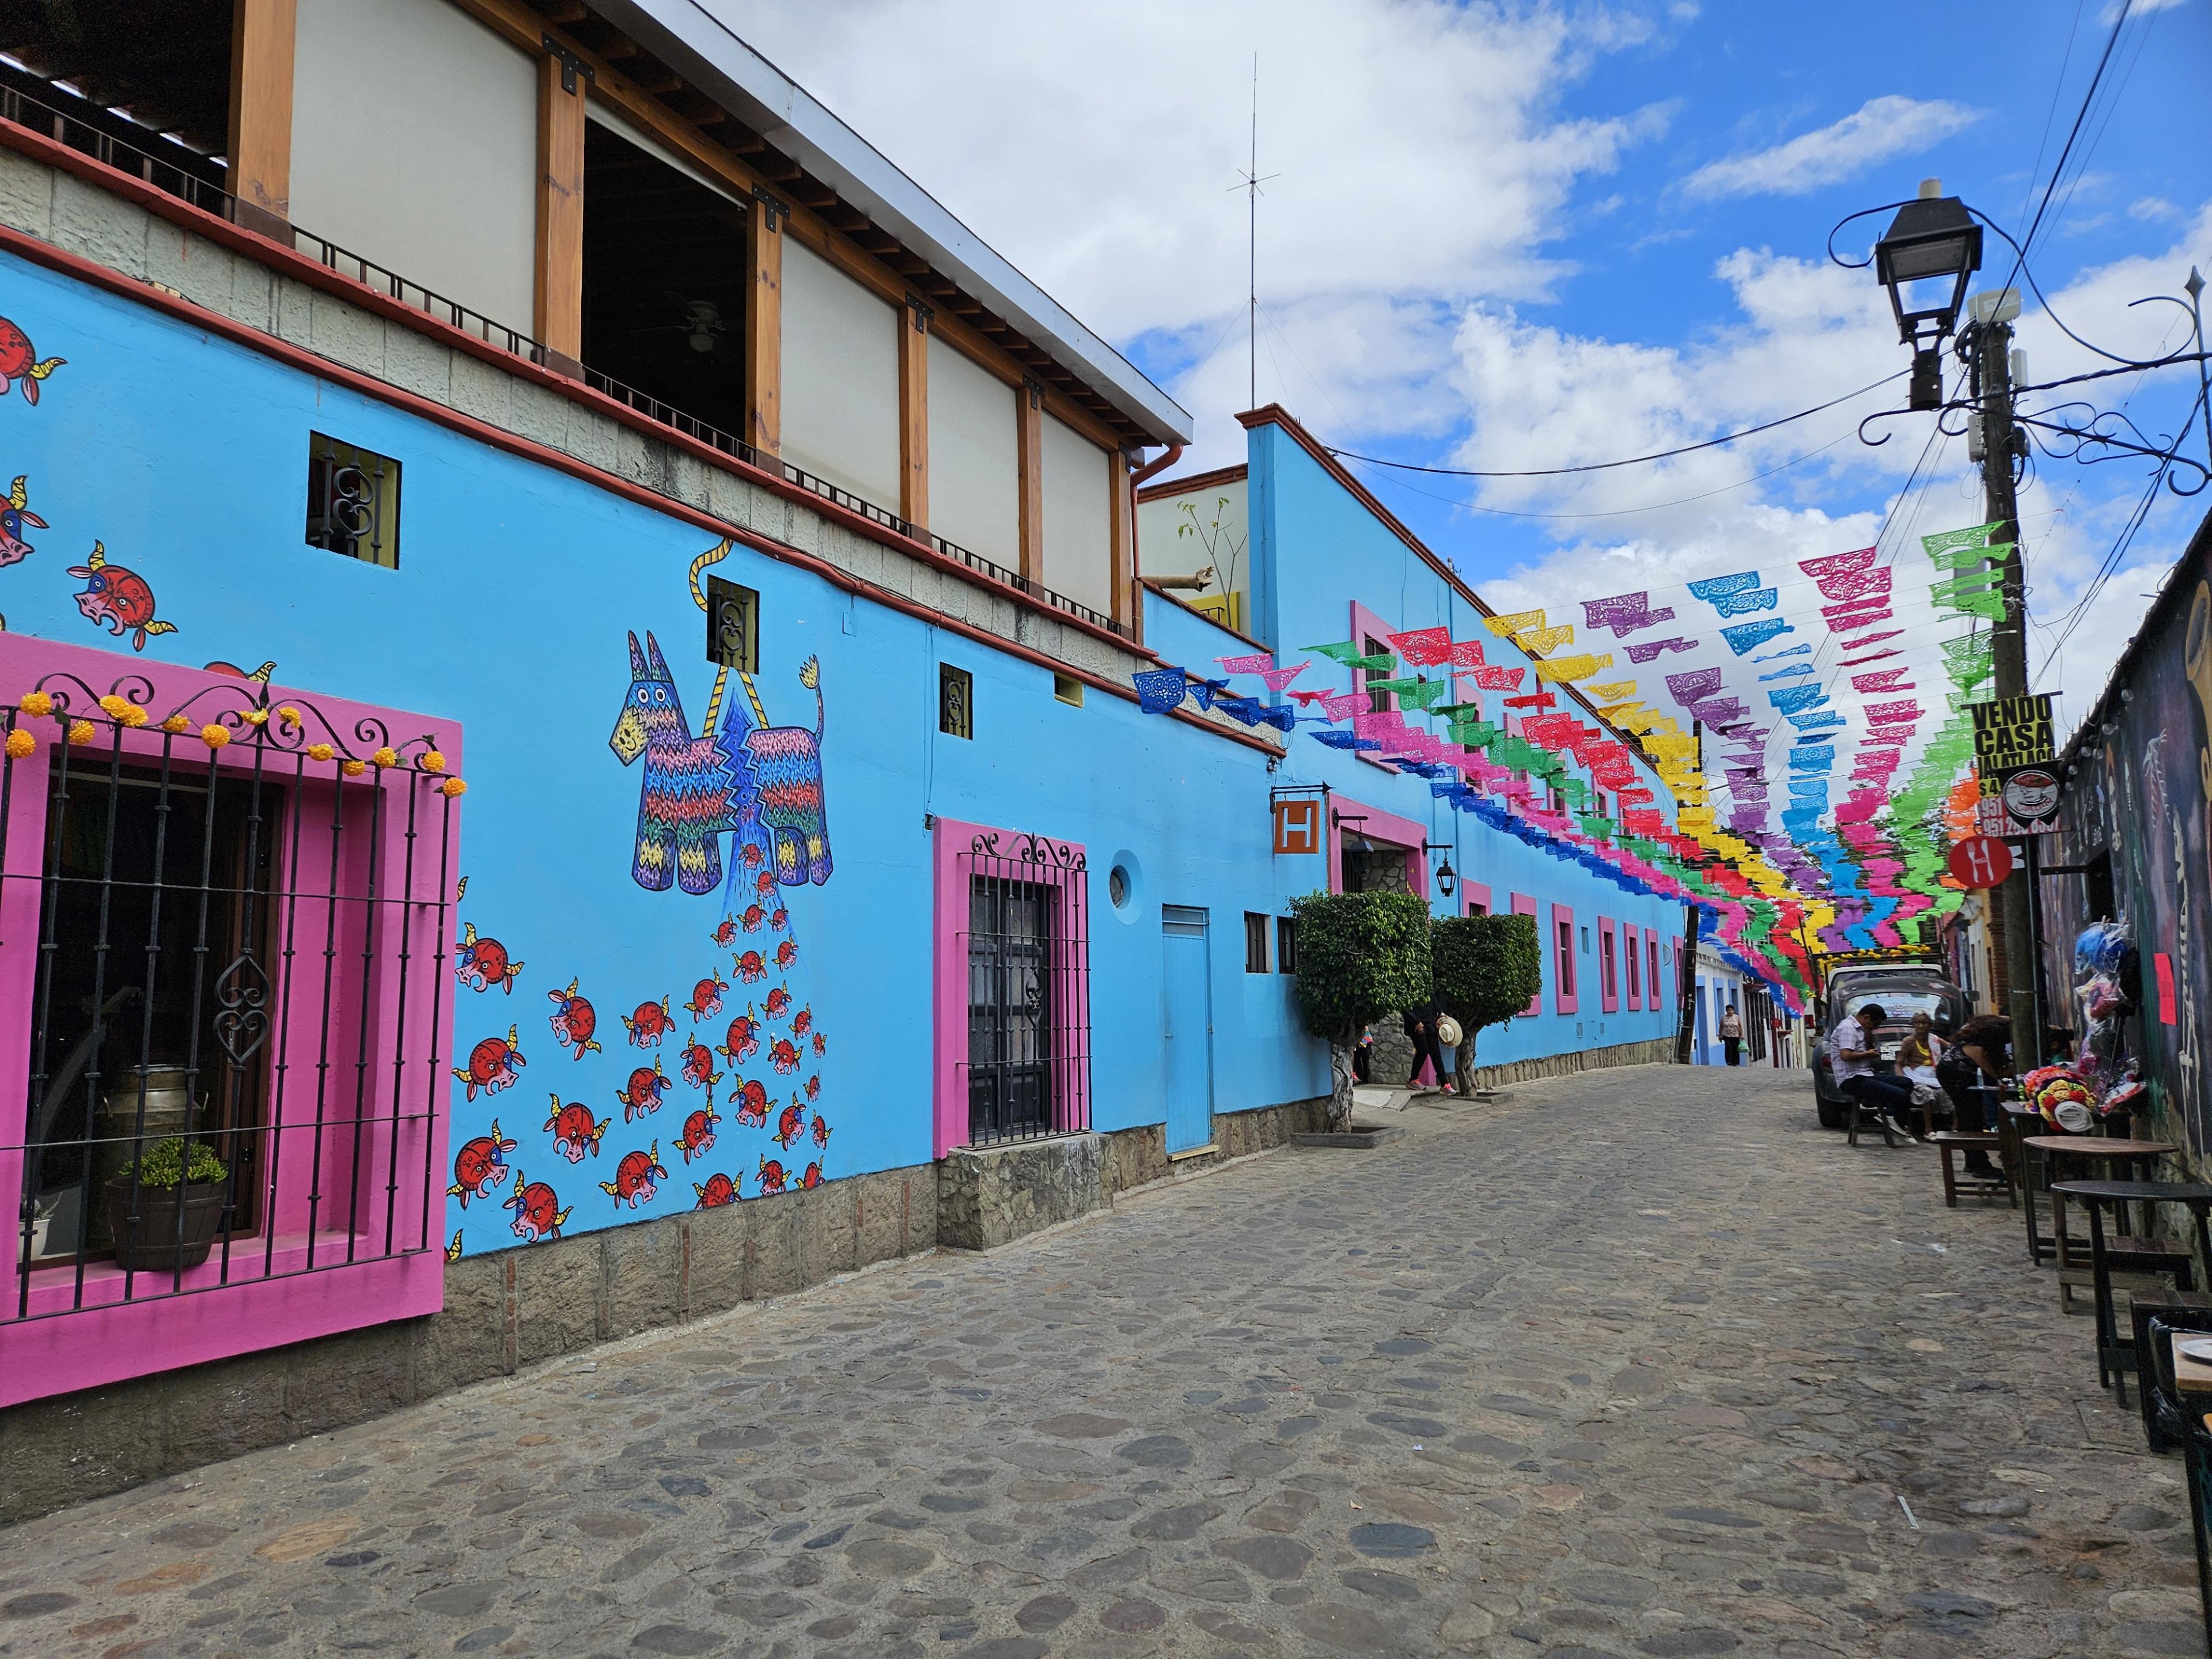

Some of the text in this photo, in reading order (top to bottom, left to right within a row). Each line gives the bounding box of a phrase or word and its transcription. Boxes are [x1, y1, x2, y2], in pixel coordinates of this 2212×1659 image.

[1971, 694, 2052, 730] VENDO
[1975, 722, 2055, 756] CASA
[1981, 797, 2002, 817] 951
[1283, 807, 1312, 847] H
[1983, 817, 2004, 838] 951
